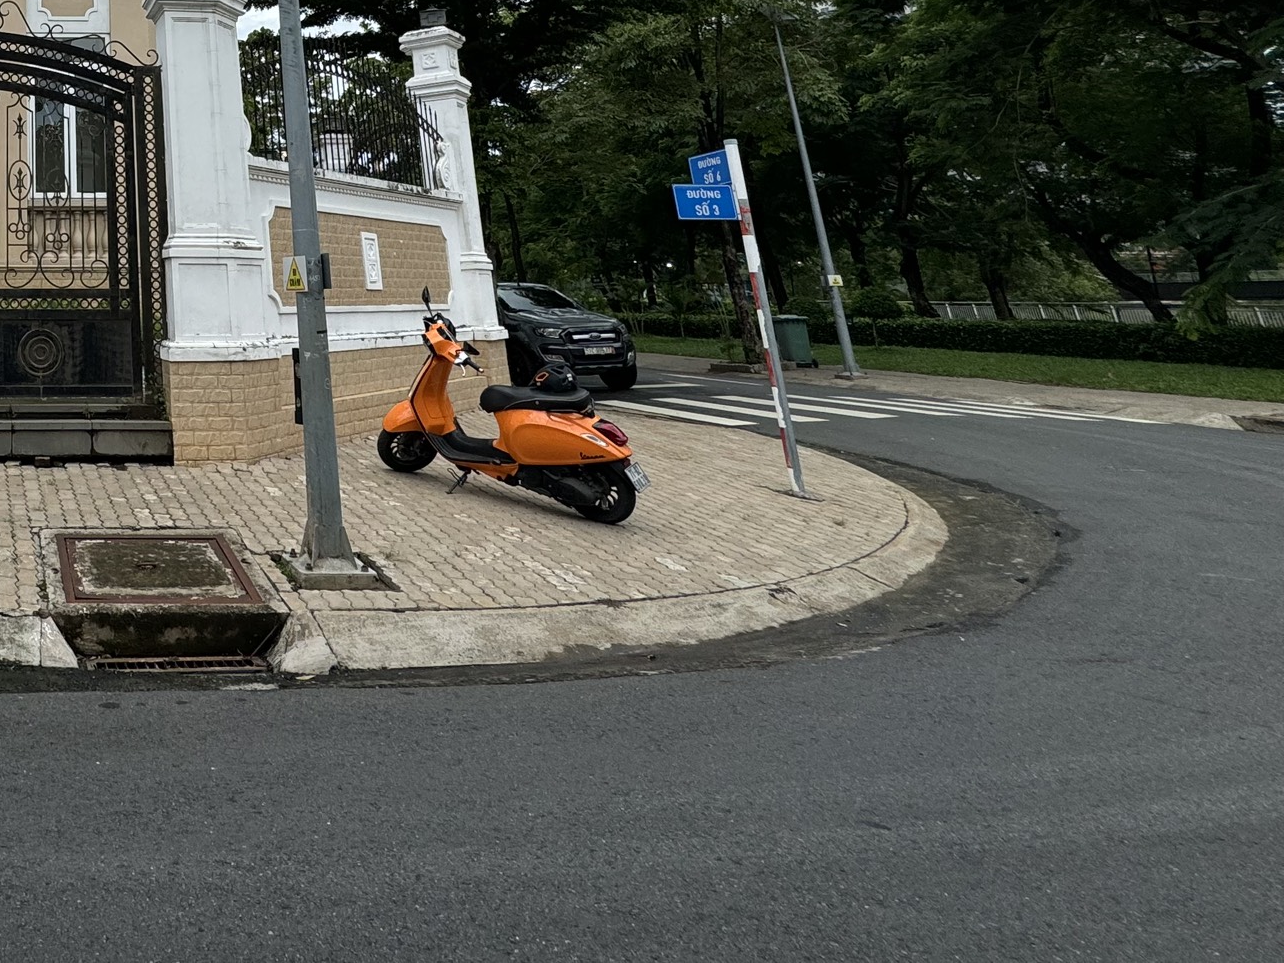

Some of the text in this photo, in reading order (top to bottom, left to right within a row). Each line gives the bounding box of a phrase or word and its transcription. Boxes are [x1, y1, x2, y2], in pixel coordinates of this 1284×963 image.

[697, 156, 722, 169] ĐƯỜNG
[703, 168, 722, 184] SỐ 6
[686, 188, 722, 199] ĐƯỜNG
[694, 200, 720, 216] SỐ 3
